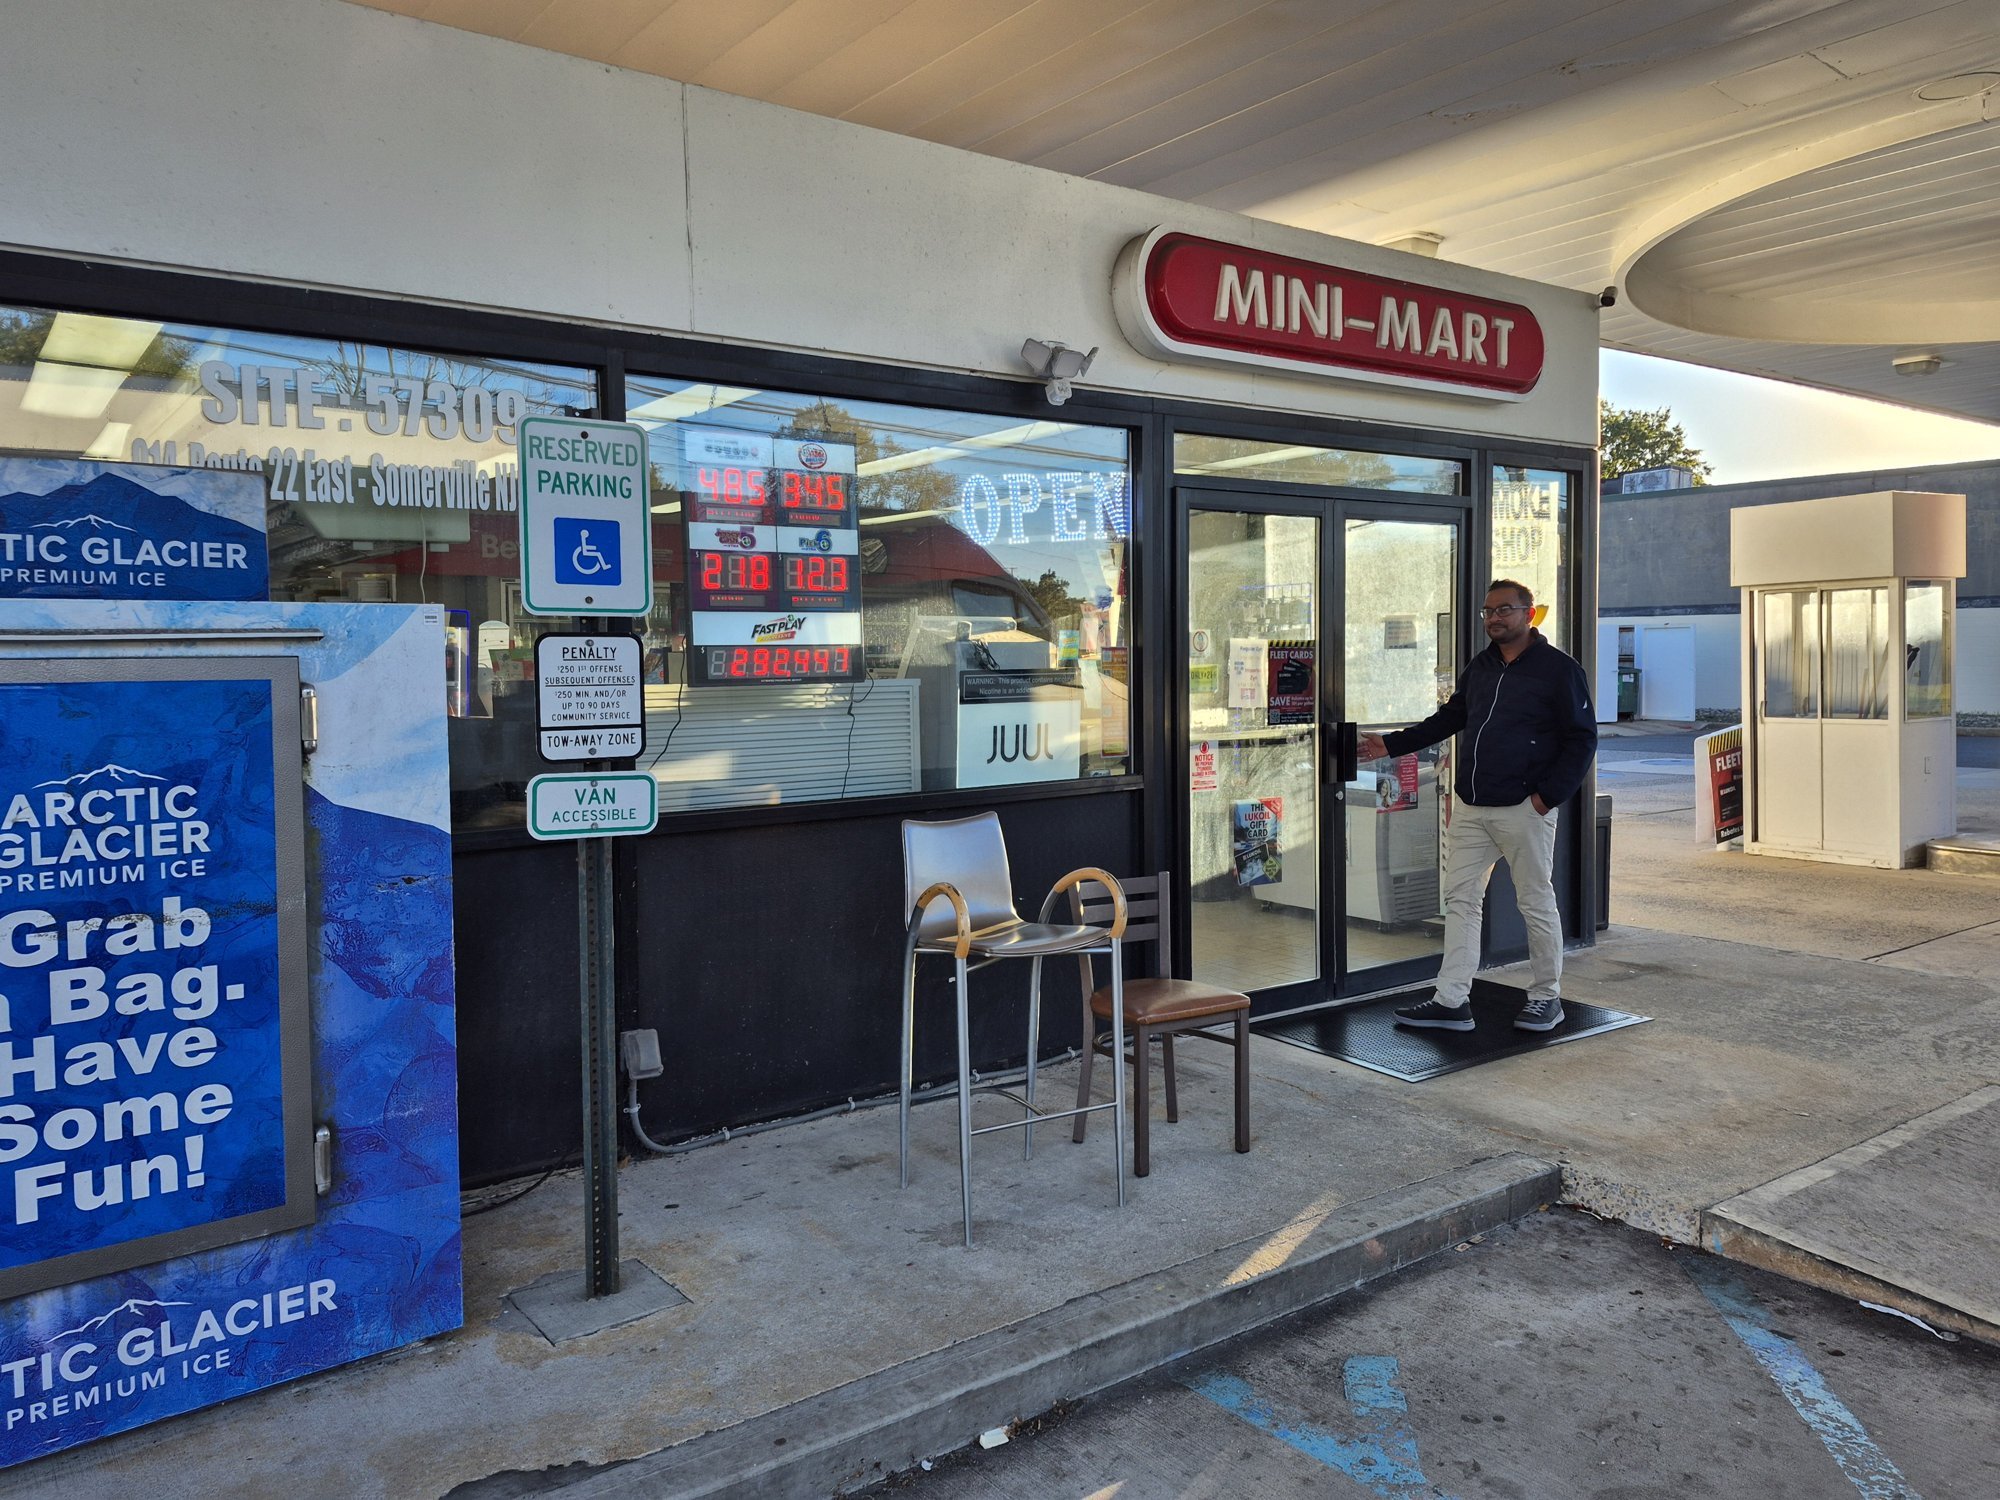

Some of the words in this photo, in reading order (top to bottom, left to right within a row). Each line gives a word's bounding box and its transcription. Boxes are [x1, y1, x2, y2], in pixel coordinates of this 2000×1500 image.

[1213, 263, 1515, 368] MINI-MART
[365, 376, 527, 446] 57309
[528, 435, 639, 467] RESERVED
[268, 446, 300, 501] 22
[303, 449, 354, 504] East
[371, 453, 490, 511] Somerville
[494, 462, 518, 512] NJ
[537, 470, 632, 500] PARKING
[699, 467, 766, 506] 485
[784, 472, 844, 510] 345
[961, 471, 1128, 546] OPEN
[0, 533, 68, 563] TIC
[81, 537, 248, 569] GLACIER
[816, 528, 832, 552] 6
[1, 568, 117, 585] PREMIUM
[129, 572, 166, 586] ICE
[703, 553, 769, 590] 218
[797, 557, 846, 591] 123
[751, 623, 777, 639] FAST
[778, 617, 807, 631] PLAY
[562, 646, 618, 659] PENALTY
[1270, 650, 1288, 659] FLEET
[1290, 650, 1313, 659] CARDS
[545, 676, 595, 686] SUBSEQUENT
[598, 675, 636, 684] OFFENSES
[557, 665, 575, 674] $250
[590, 664, 623, 673] OFFENSE
[1010, 677, 1031, 686] product
[555, 690, 572, 699] $250
[594, 688, 627, 699] AND/OR
[562, 702, 573, 710] UP
[576, 701, 585, 710] TO
[588, 701, 598, 709] 90
[601, 700, 620, 709] DAYS
[1270, 696, 1290, 707] SAVE
[551, 712, 597, 722] COMMUNITY
[599, 711, 630, 721] SERVICE
[547, 734, 603, 748] TOW-AWAY
[608, 732, 636, 746] ZONE
[987, 723, 1054, 764] JUUL
[1194, 754, 1214, 762] NOTICE
[1716, 751, 1742, 772] FLEET
[1, 785, 198, 830] ARCTIC
[574, 787, 616, 805] VAN
[1251, 803, 1264, 812] THE
[552, 808, 637, 824] ACCESSIBLE
[1245, 812, 1270, 821] LUKOIL
[0, 820, 211, 869] GLACIER
[1248, 829, 1268, 838] CARD
[0, 864, 145, 894] PREMIUM
[161, 859, 206, 880] ICE
[0, 896, 211, 968] Grab
[49, 965, 244, 1025] Bag.
[0, 1027, 217, 1098] Have
[0, 1083, 233, 1163] Some
[14, 1134, 205, 1225] Fun!
[1, 1342, 97, 1398] TIC
[117, 1278, 338, 1366] GLACIER
[7, 1367, 166, 1430] PREMIUM
[182, 1349, 230, 1379] ICE
